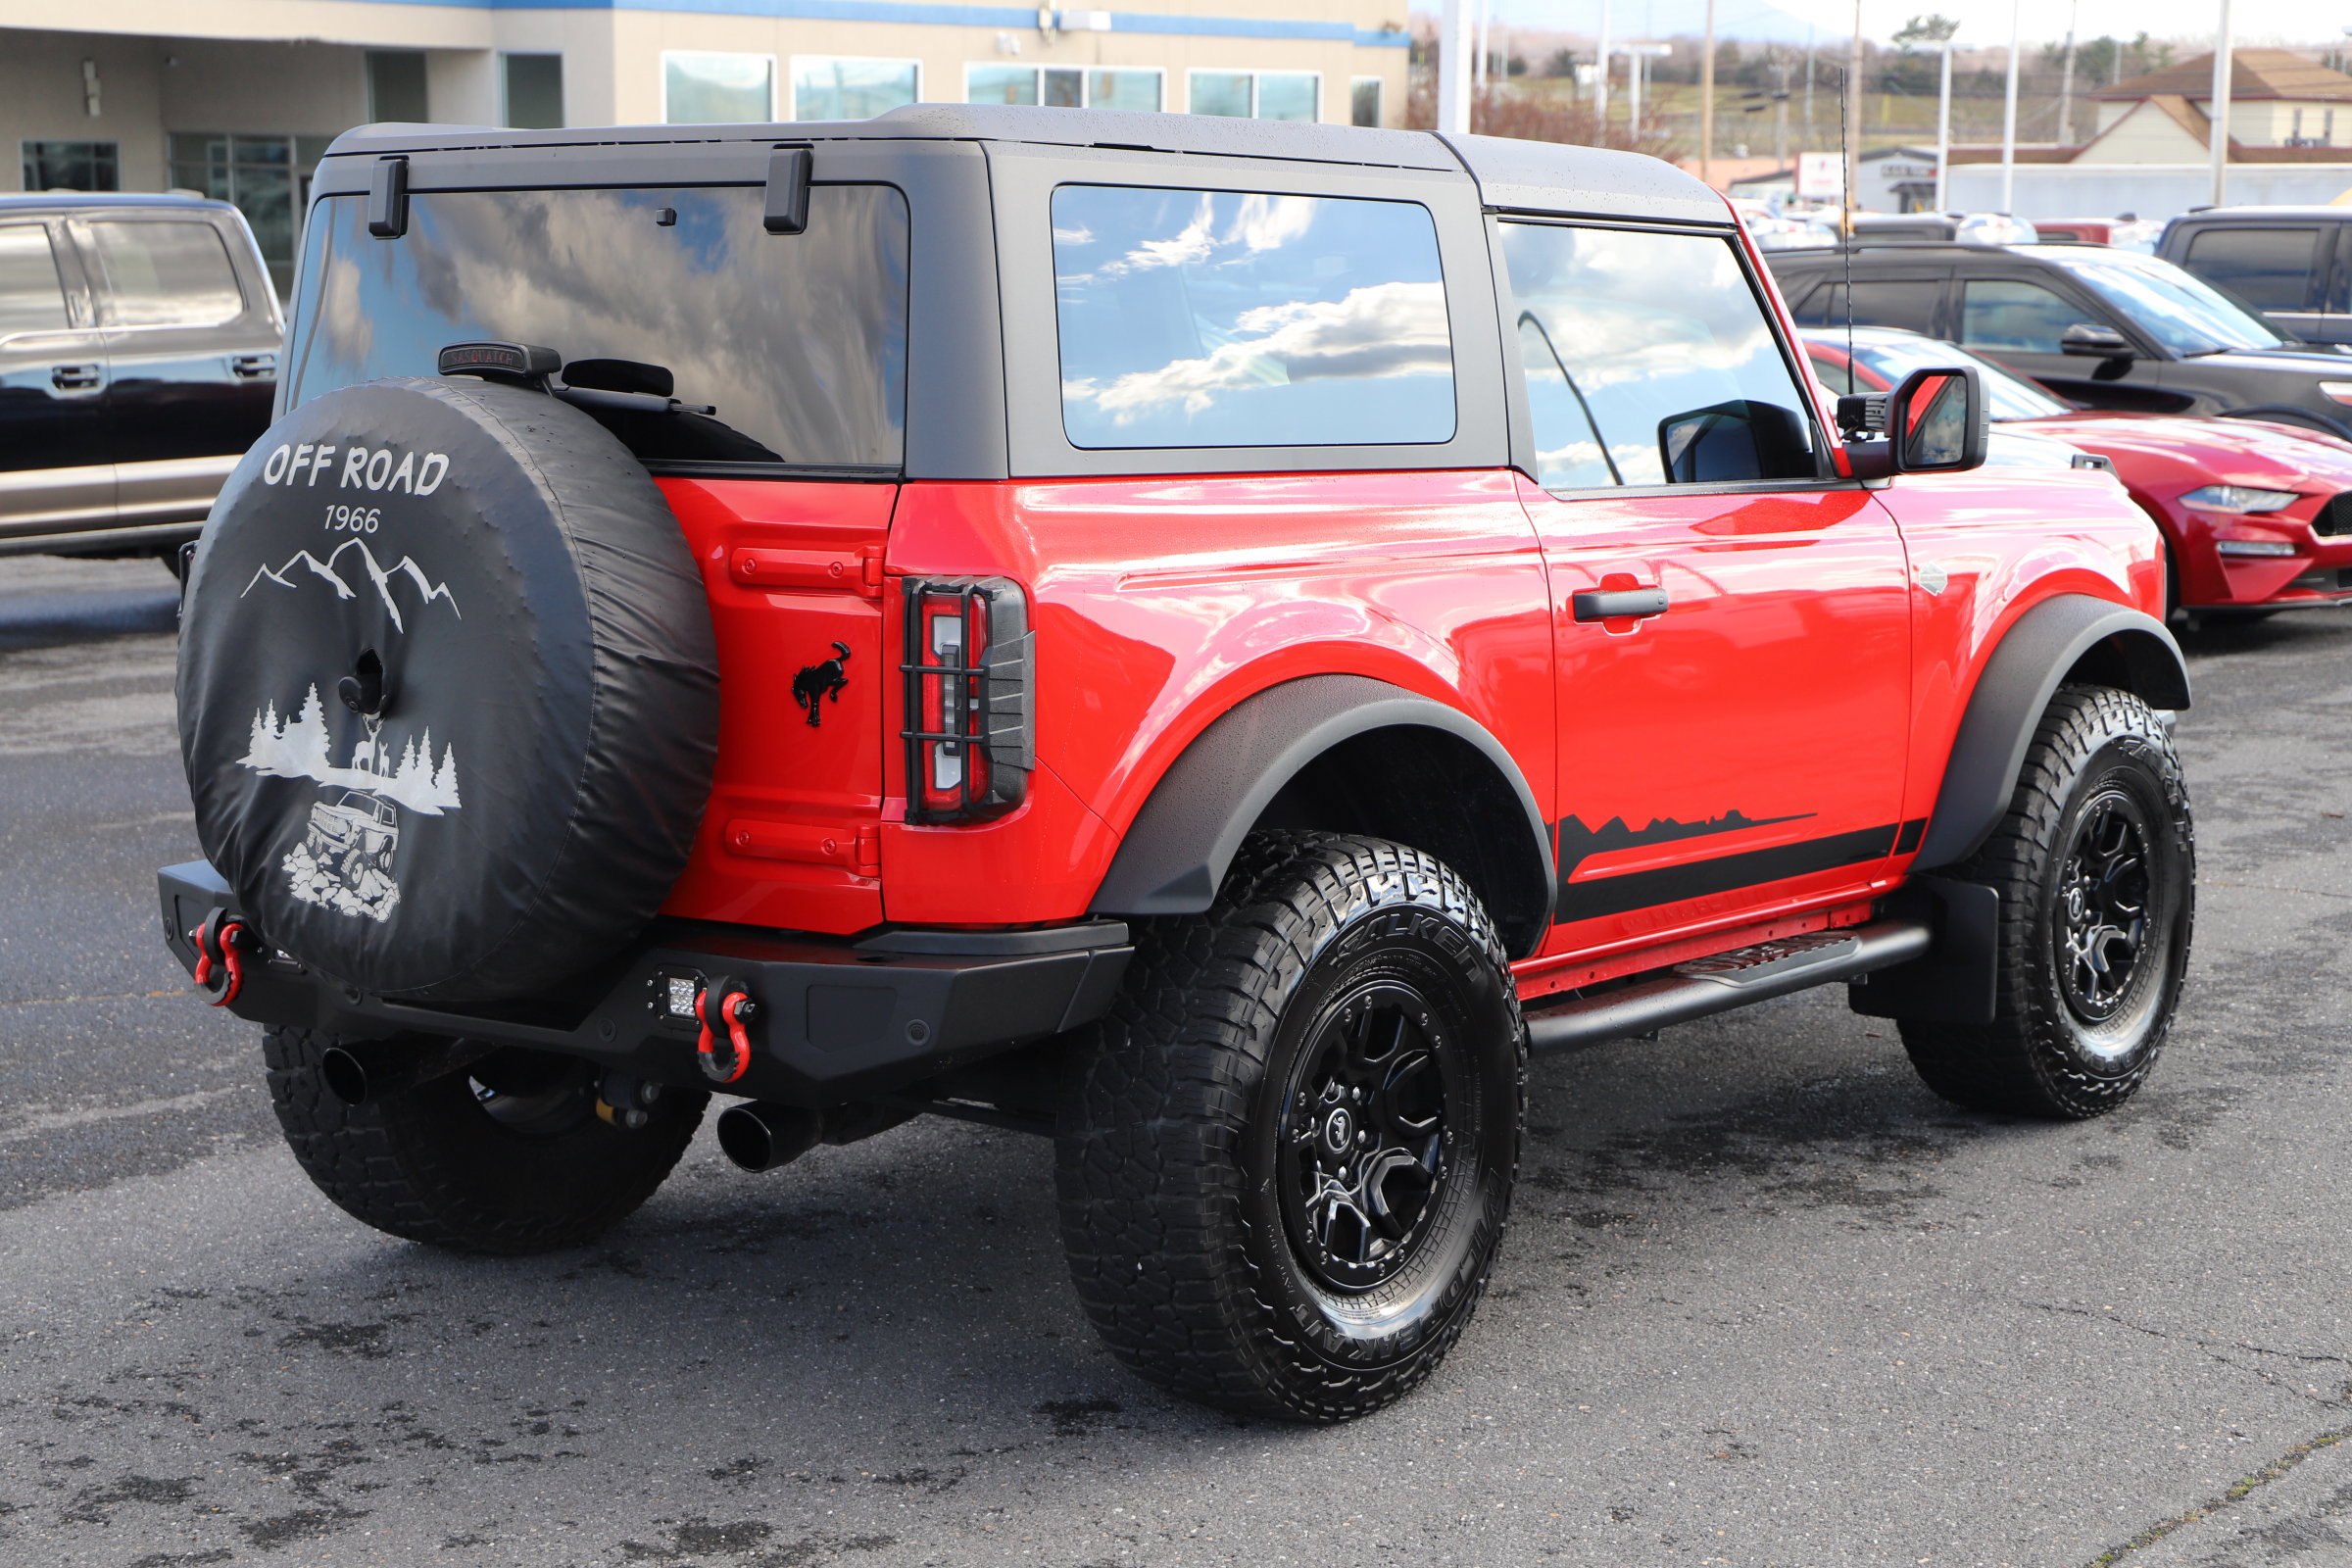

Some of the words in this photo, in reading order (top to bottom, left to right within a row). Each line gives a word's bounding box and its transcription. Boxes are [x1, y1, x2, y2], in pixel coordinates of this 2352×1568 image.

[454, 350, 514, 364] SASQUATCH
[264, 443, 336, 487] OFF
[340, 446, 450, 496] ROAD
[324, 504, 381, 534] 1966
[1329, 912, 1484, 982] FALKEN
